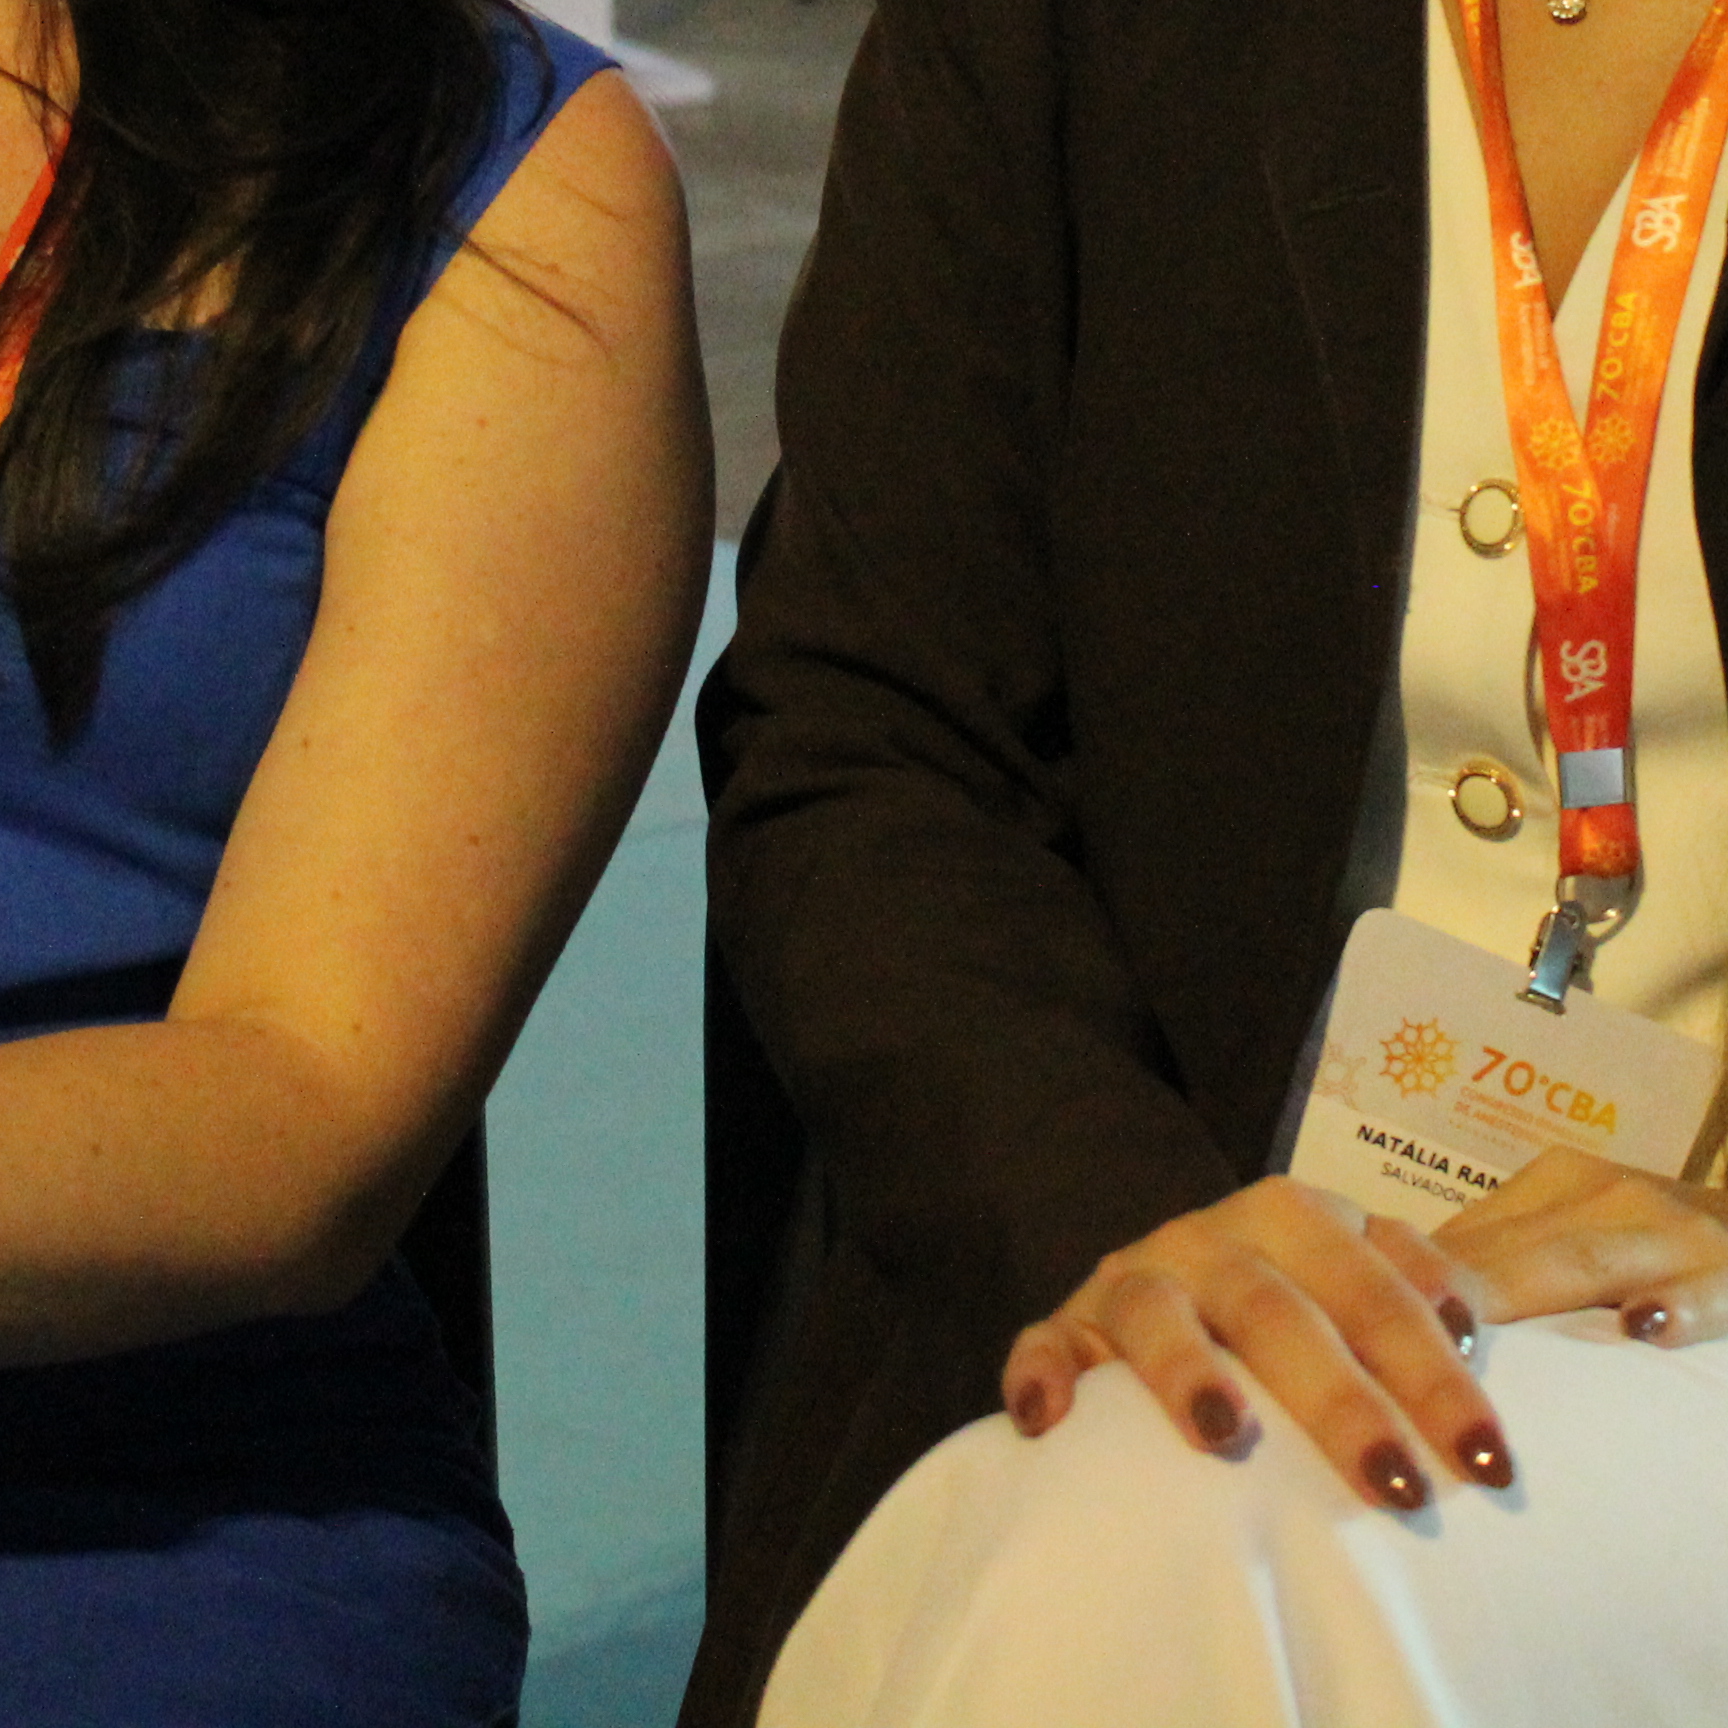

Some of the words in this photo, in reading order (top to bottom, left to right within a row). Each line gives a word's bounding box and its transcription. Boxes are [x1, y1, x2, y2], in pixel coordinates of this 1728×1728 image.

[1630, 193, 1690, 253] SBA
[1560, 638, 1608, 702] SBA
[1356, 1122, 1451, 1175] NATÁLIA
[1380, 1161, 1466, 1205] SALVADOR
